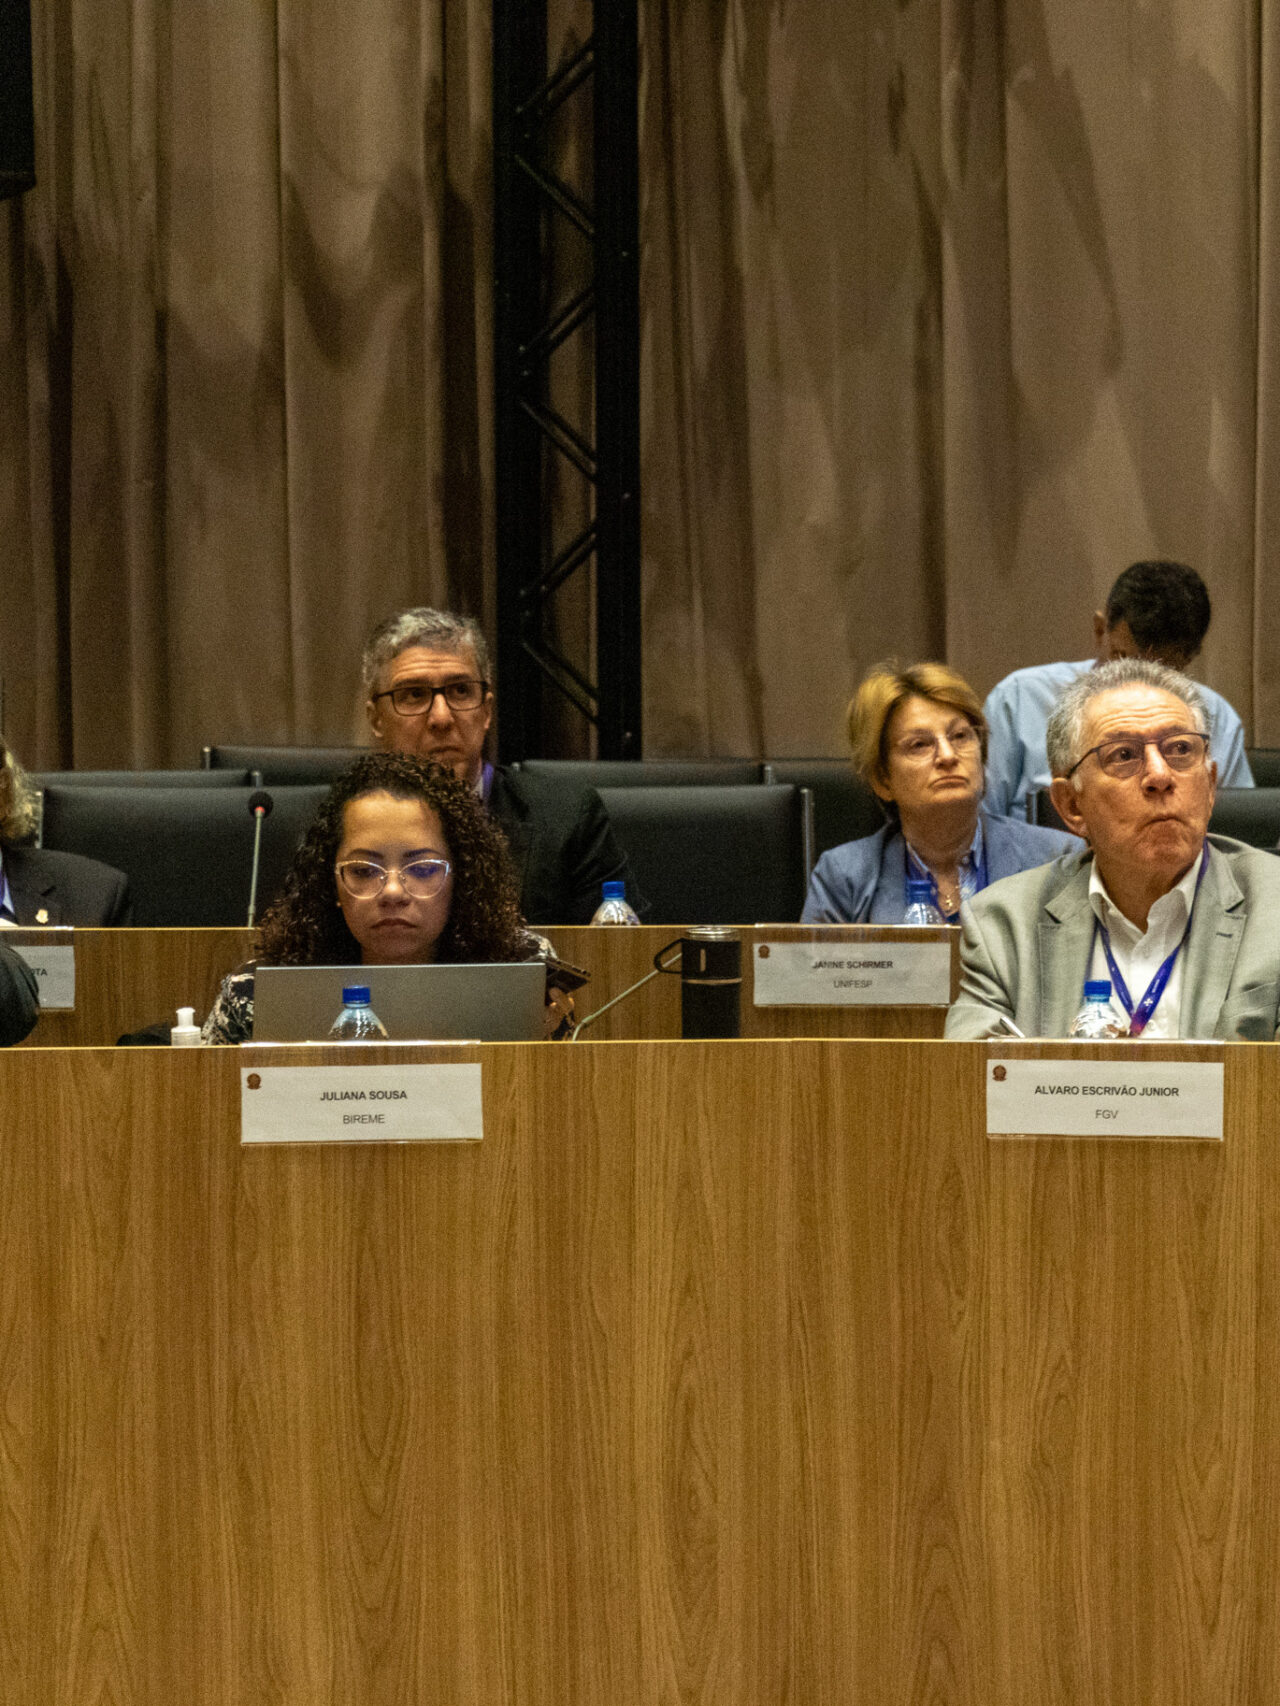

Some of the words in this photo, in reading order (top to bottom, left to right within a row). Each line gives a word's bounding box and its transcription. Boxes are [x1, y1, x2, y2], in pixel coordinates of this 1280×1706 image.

[812, 960, 844, 969] JANINE
[846, 960, 894, 969] SCHIRMER
[833, 979, 873, 989] UNIFESP
[320, 1091, 367, 1101] JULIANA
[368, 1090, 408, 1100] SOUSA
[1034, 1085, 1080, 1096] ALVARO
[1081, 1084, 1137, 1097] ESCRIVÃO
[1138, 1086, 1180, 1097] JUNIOR
[342, 1114, 386, 1125] BIREME
[1094, 1109, 1119, 1120] FGV
